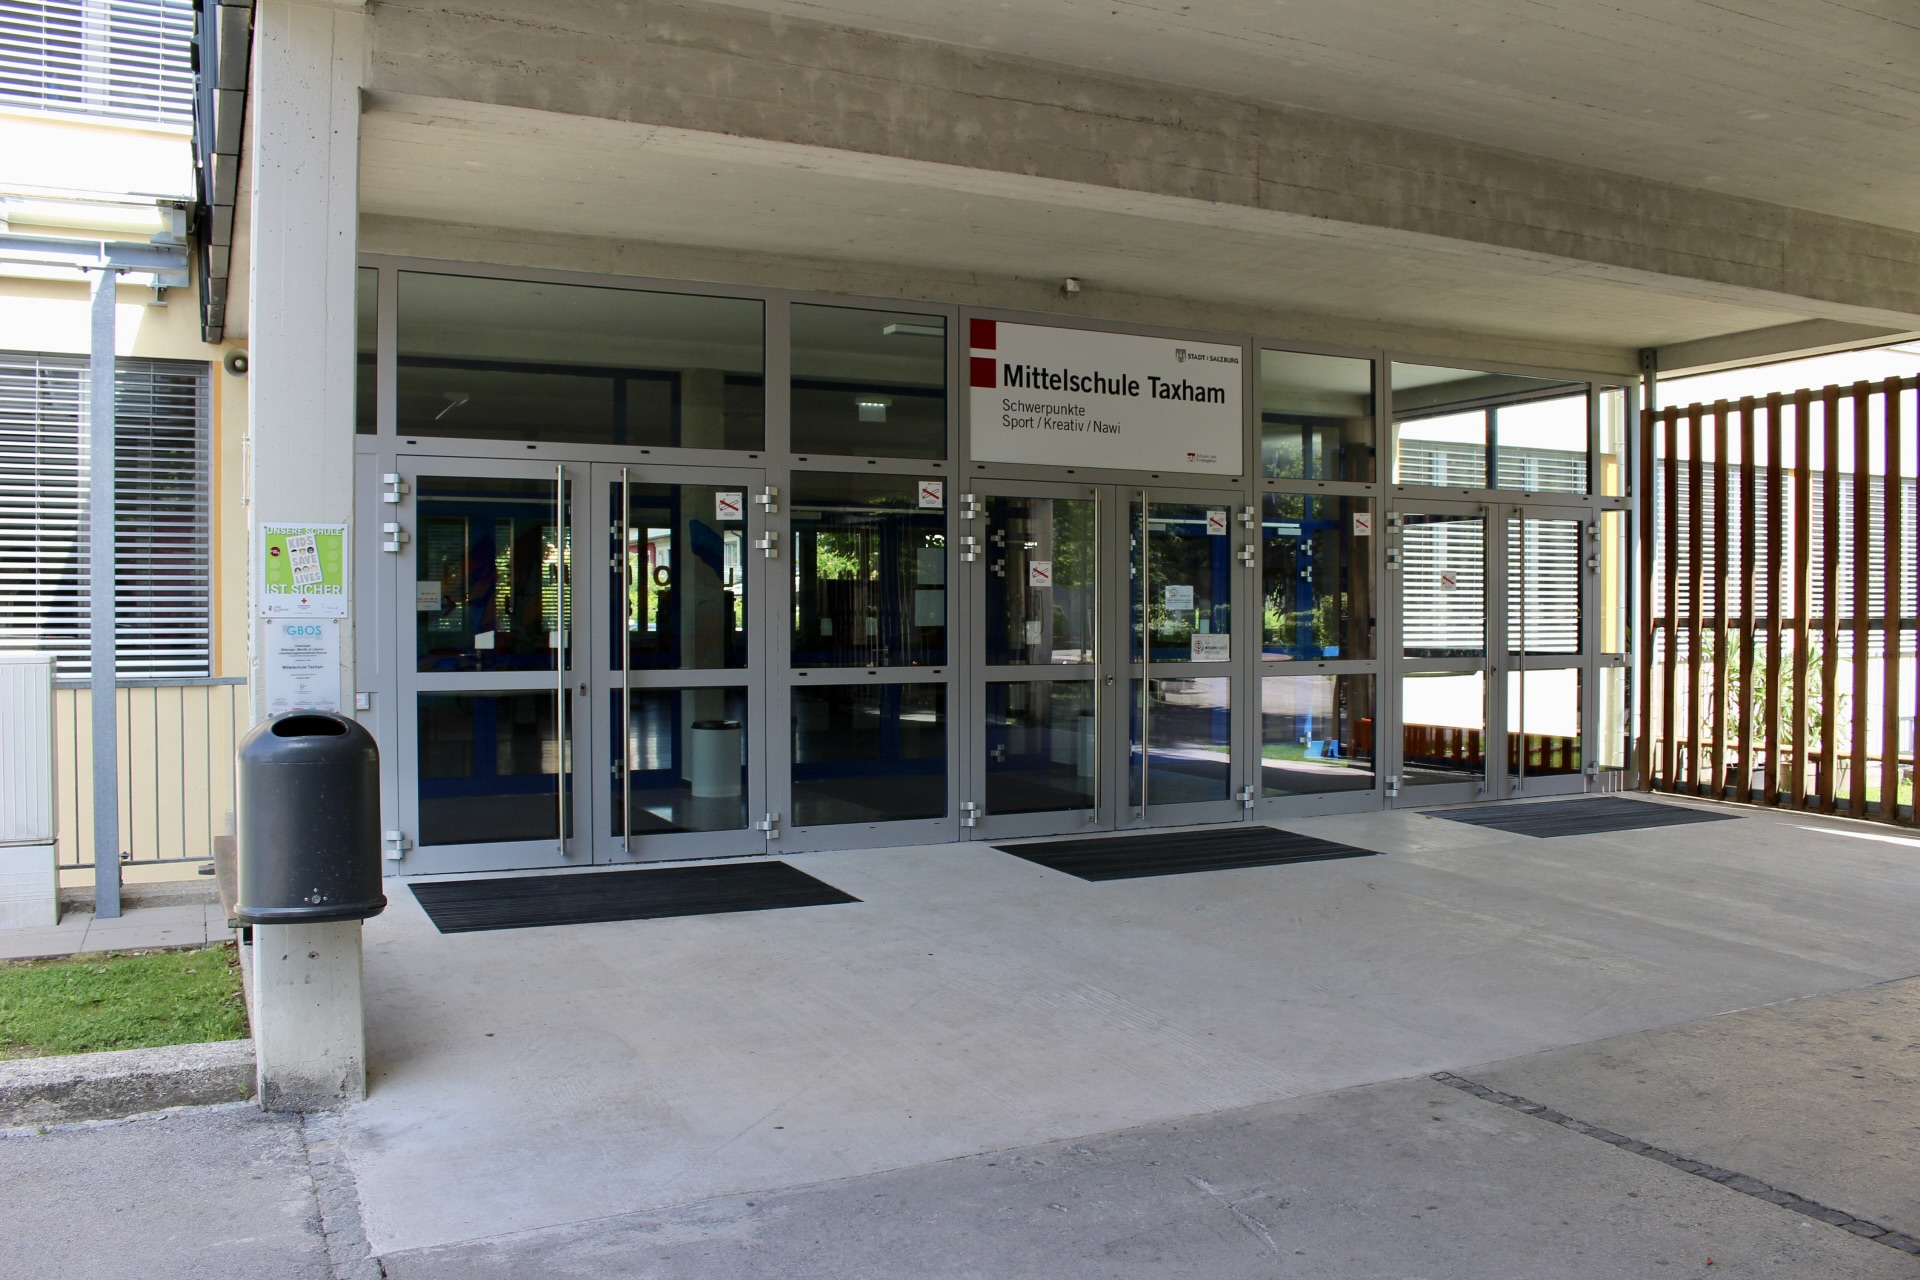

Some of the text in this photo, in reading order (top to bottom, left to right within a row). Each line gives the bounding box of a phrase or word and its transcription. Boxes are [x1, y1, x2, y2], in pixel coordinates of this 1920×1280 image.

[1187, 353, 1205, 361] STADT
[1209, 355, 1239, 364] SALZBURG
[1003, 363, 1226, 404] Mittelschule Taxham
[1002, 398, 1086, 417] Schwerpunkte
[1002, 415, 1035, 431] Sport
[1043, 417, 1085, 432] Kreativ
[1093, 420, 1121, 434] Nawi
[266, 527, 342, 536] UNSERE SCHULE
[288, 536, 314, 549] KIDS
[292, 555, 318, 566] SAVE
[295, 572, 321, 584] LIVES
[266, 584, 342, 594] IST SICHER
[287, 625, 322, 636] GBOS
